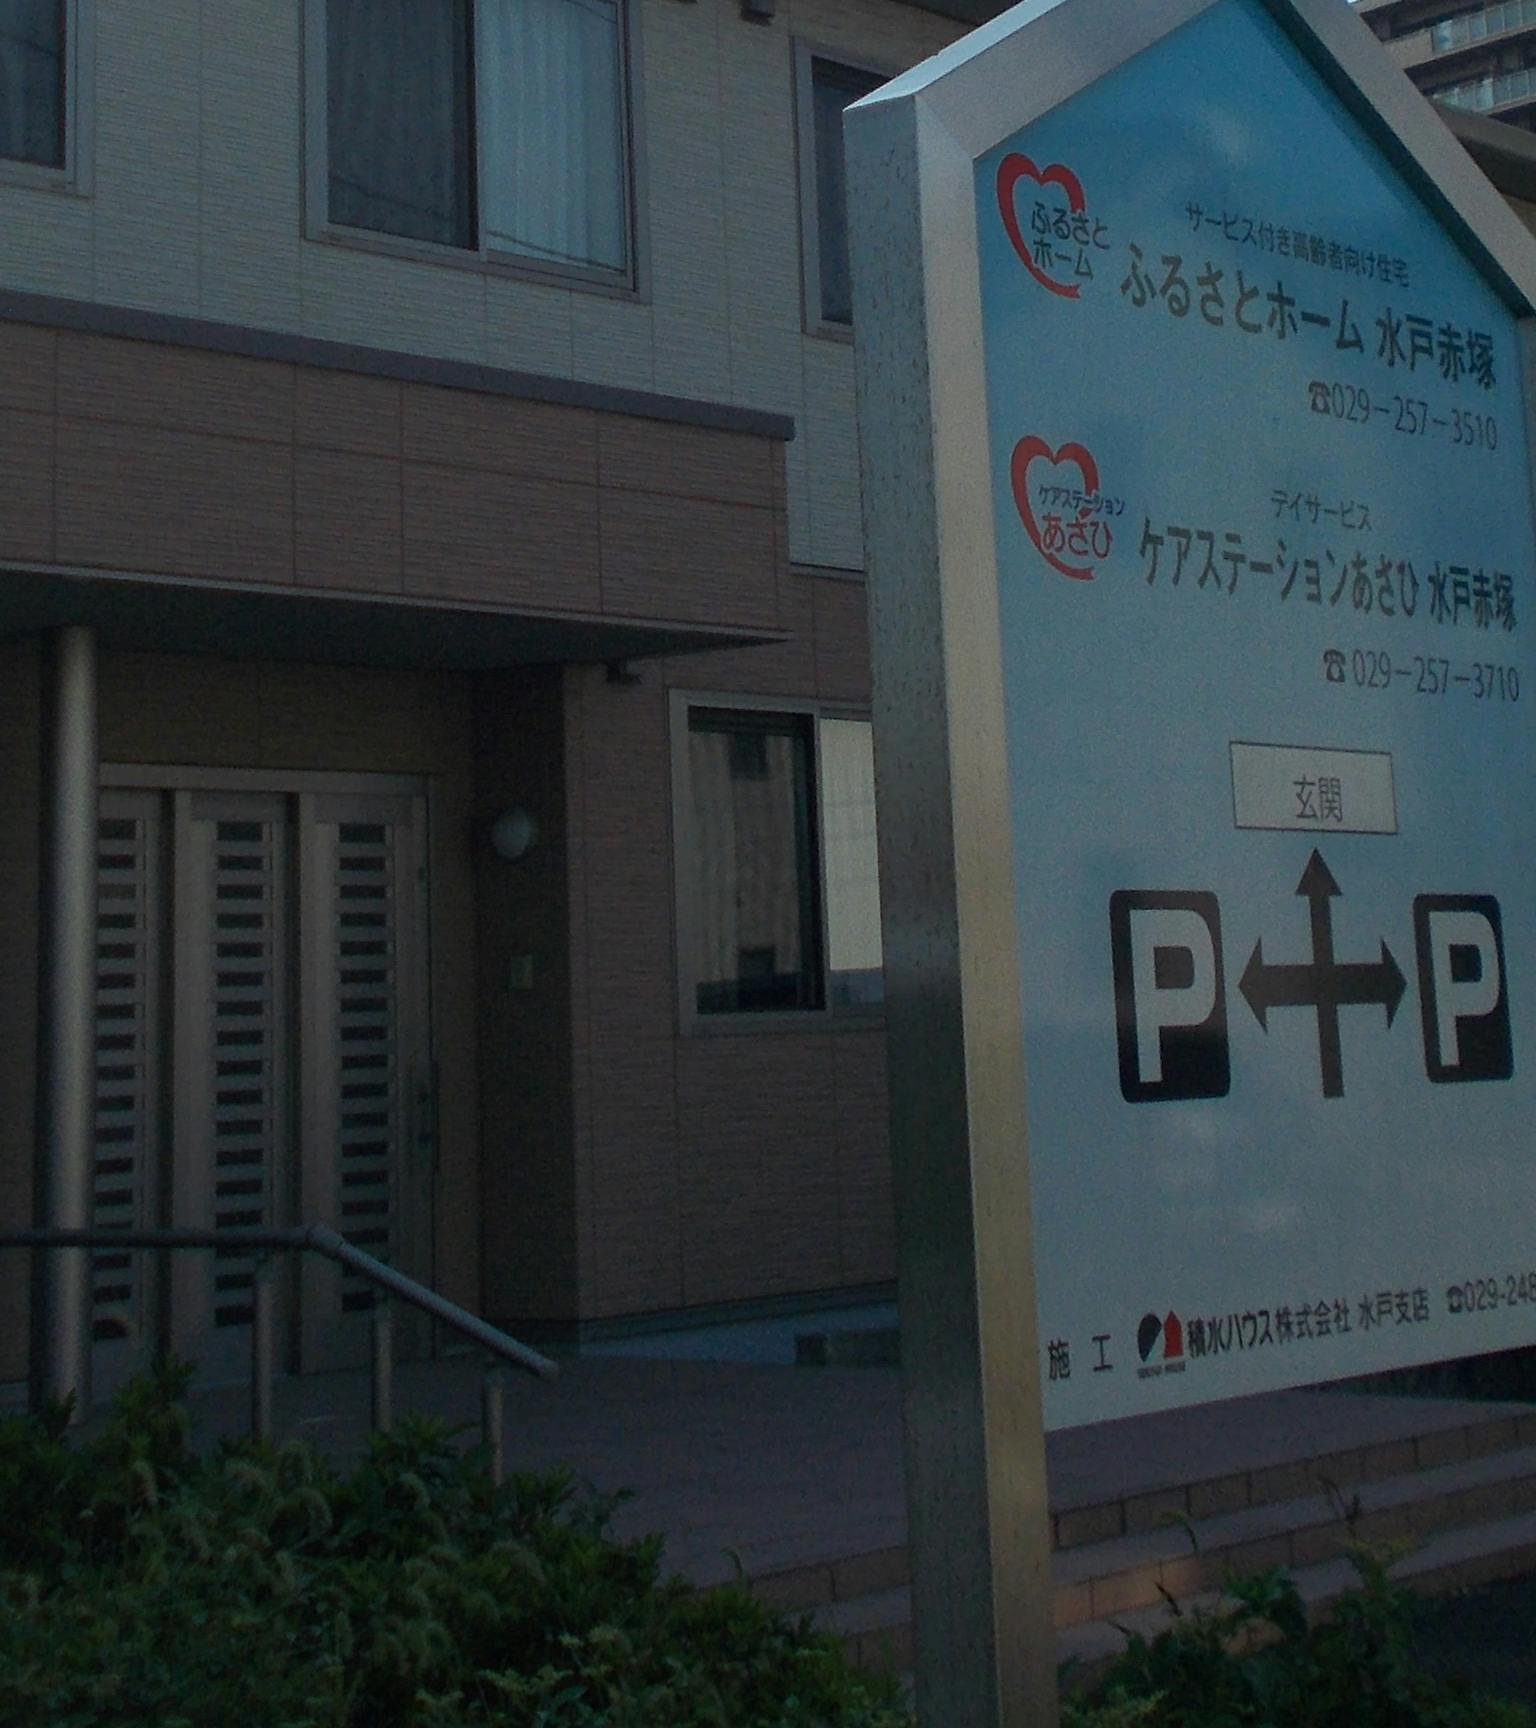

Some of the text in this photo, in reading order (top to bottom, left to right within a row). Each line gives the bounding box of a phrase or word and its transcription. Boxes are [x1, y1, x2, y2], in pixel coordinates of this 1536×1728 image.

[1031, 201, 1110, 251] ふるさと
[1032, 236, 1094, 281] ホーム
[1184, 200, 1410, 288] サービス付き高齢者向け住宅
[1119, 242, 1497, 391] ふるさとホーム 水戸赤塚
[1038, 483, 1126, 517] ケアステーション
[1041, 511, 1114, 559] あさひ
[1139, 515, 1517, 632] ケアステーションあさひ 水戸赤塚
[1293, 773, 1343, 822] 玄関
[1129, 908, 1217, 1084] P
[1428, 910, 1500, 1067] P
[1186, 1296, 1353, 1358] 積水ハウス株式会社
[1357, 1285, 1431, 1331] 水戸支店
